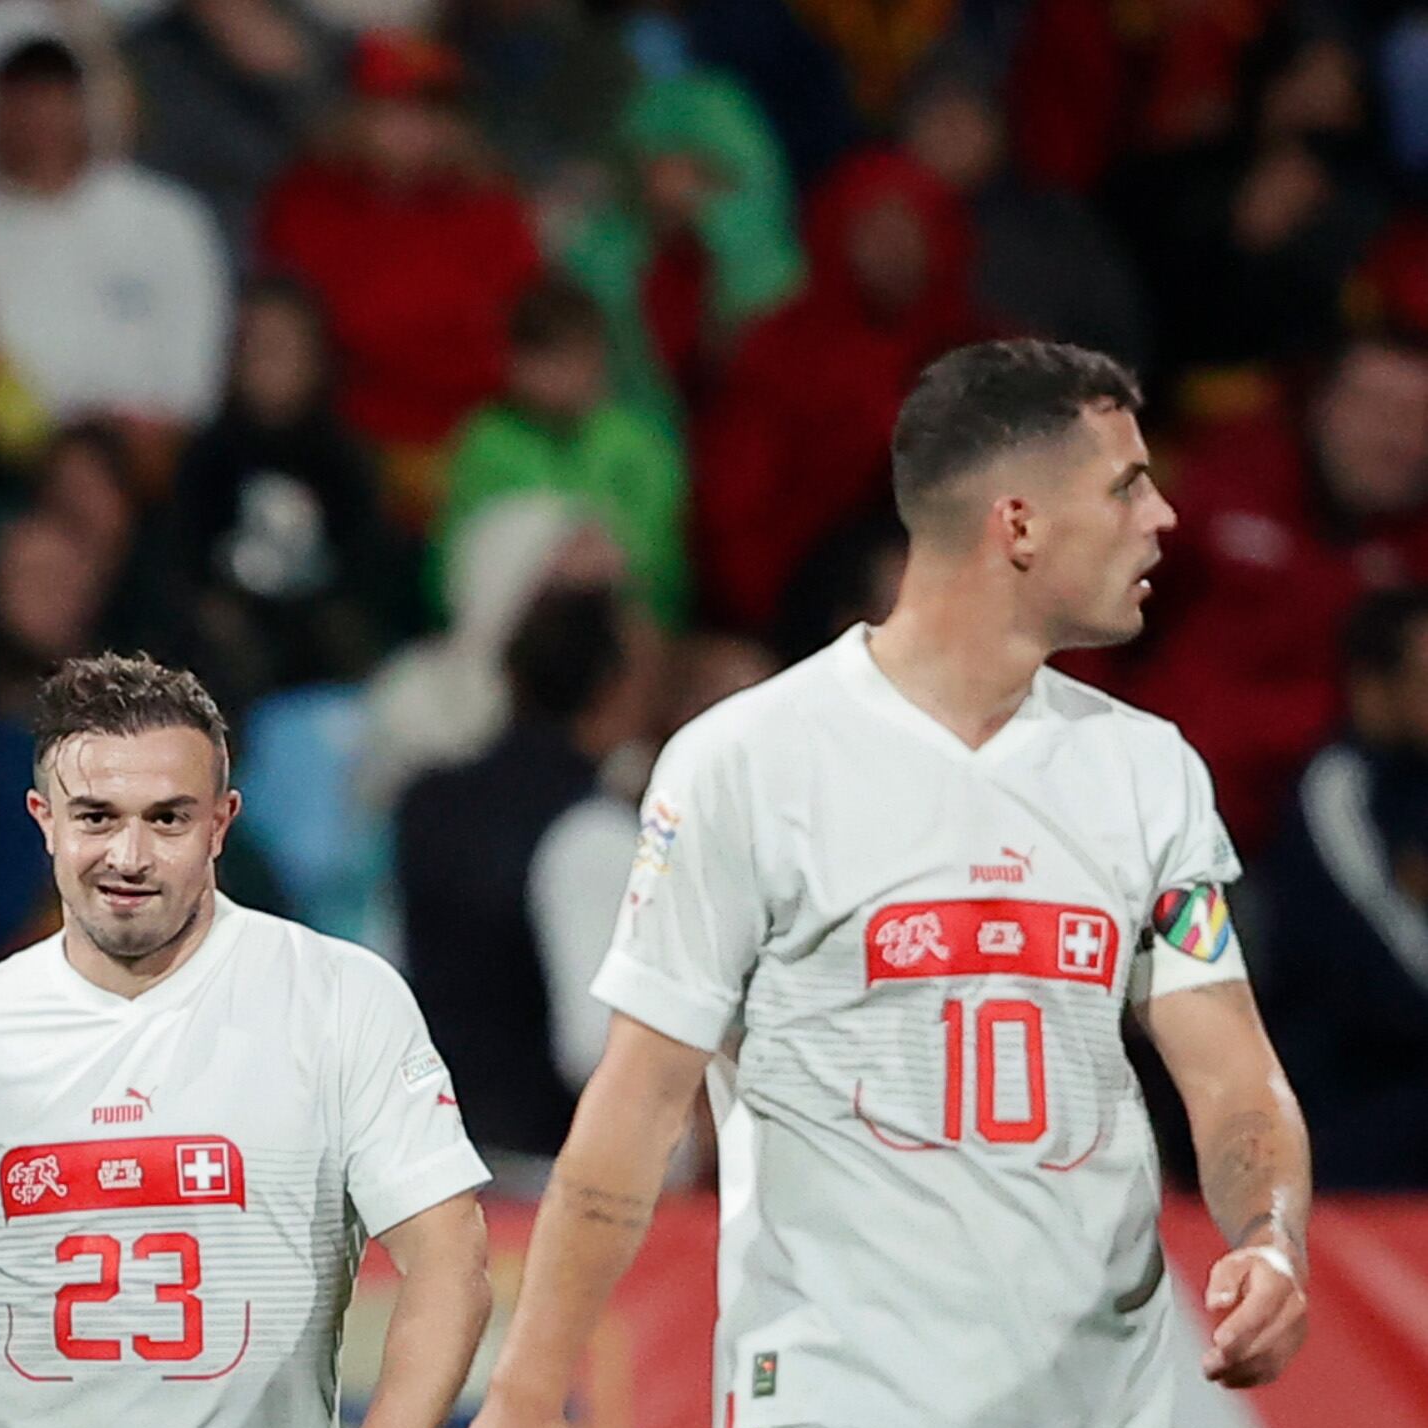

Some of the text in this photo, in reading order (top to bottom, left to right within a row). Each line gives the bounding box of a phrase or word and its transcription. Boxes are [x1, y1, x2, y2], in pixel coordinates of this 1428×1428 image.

[969, 864, 1024, 884] PUMA
[940, 998, 1049, 1144] 10
[93, 1104, 143, 1125] PUMA
[53, 1231, 207, 1363] 23
